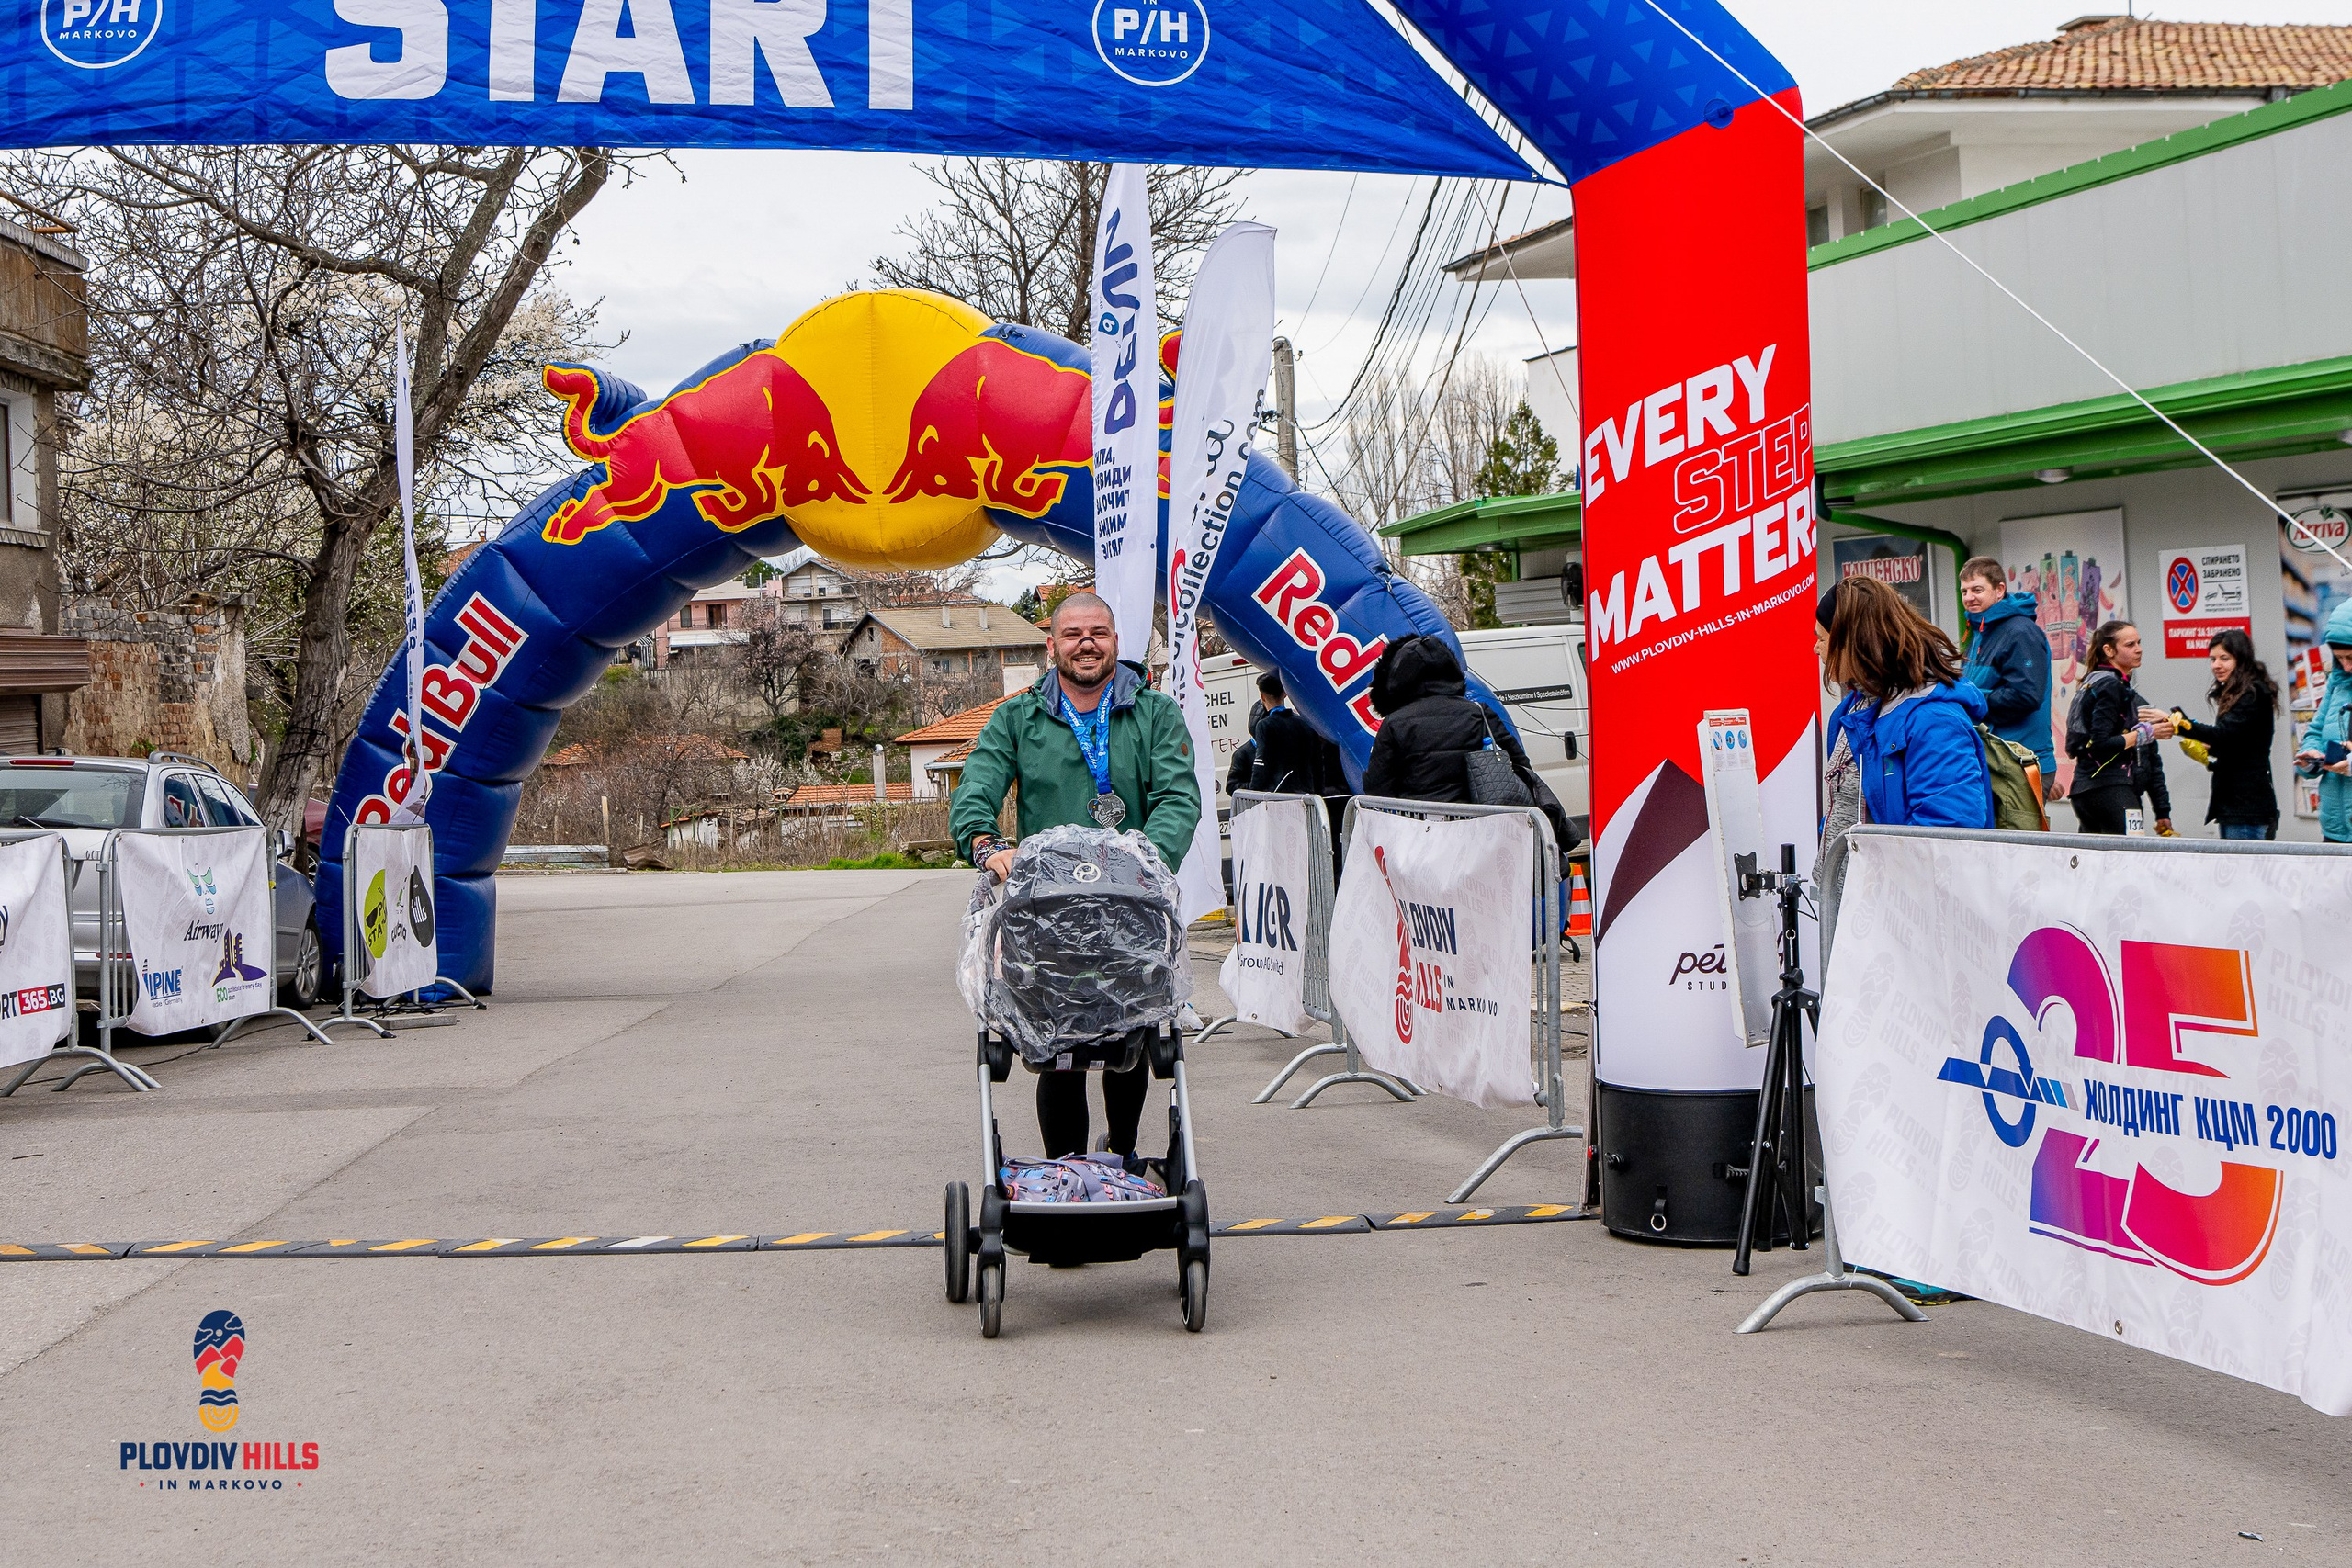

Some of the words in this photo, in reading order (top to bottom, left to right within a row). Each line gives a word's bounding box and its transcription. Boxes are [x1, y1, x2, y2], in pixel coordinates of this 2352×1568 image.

[59, 29, 137, 39] MARKOVO
[1114, 8, 1189, 45] P/H
[1114, 47, 1189, 60] MARKOVO
[1585, 343, 1777, 509] EVERY
[1673, 402, 1812, 535] STEP
[2293, 519, 2345, 540] Arriva
[2202, 554, 2240, 566] СПИРАНЕТО
[2202, 567, 2241, 579] ЗАБРАНЕНО
[1253, 547, 1390, 694] Red
[1611, 571, 1815, 675] WWW.PLOVDIV-HILLS-IN-MARKOVO.COM
[2168, 627, 2197, 638] ПАРКИНГ
[420, 595, 524, 728] Bull
[1687, 981, 1727, 991] STUD
[2269, 946, 2352, 1013] PLOVDI
[1445, 997, 1498, 1016] MARKOVO
[2084, 1078, 2184, 1138] ХОЛДИНГ
[2194, 1096, 2259, 1152] КЦМ
[2267, 1104, 2337, 1160] 2000
